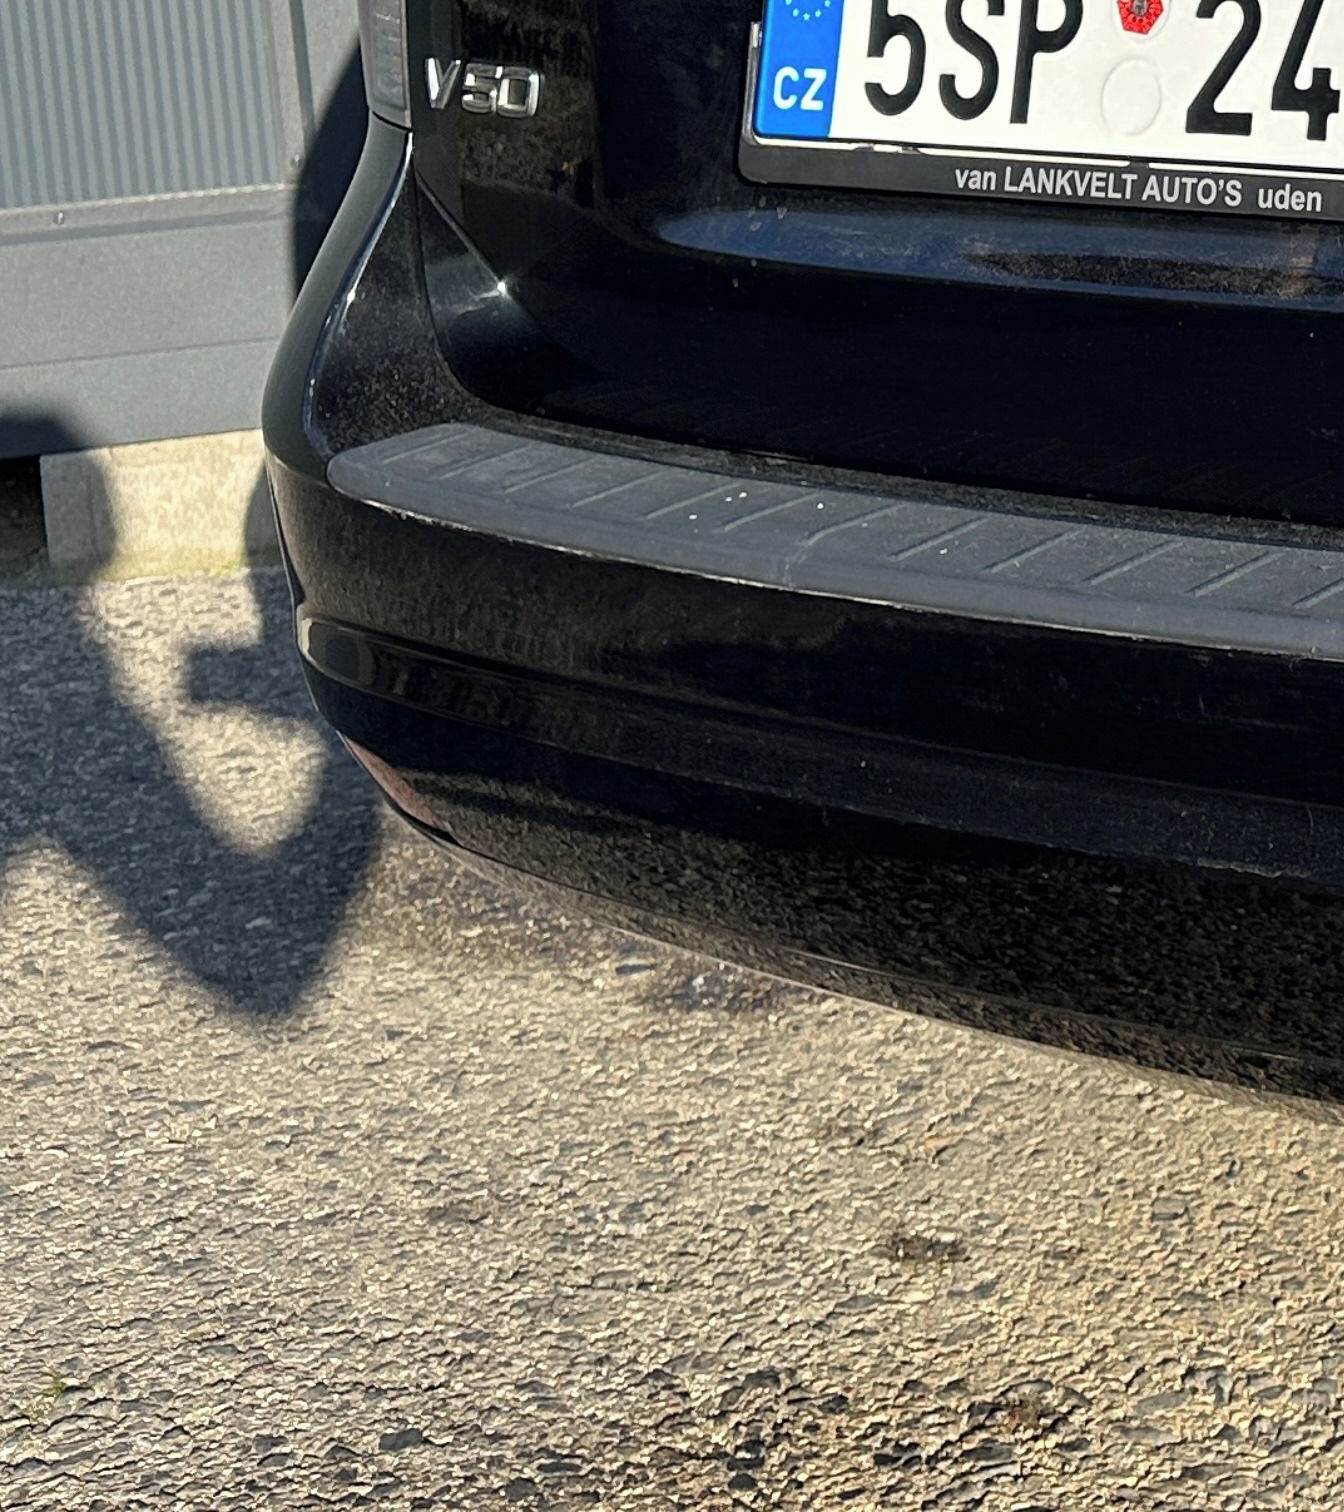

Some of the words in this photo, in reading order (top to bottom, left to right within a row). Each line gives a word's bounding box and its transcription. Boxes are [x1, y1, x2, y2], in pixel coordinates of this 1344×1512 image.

[424, 57, 541, 118] V50
[771, 67, 826, 113] CZ
[954, 168, 997, 191] van
[1003, 166, 1138, 200] LANKVELT
[1257, 184, 1322, 212] uden
